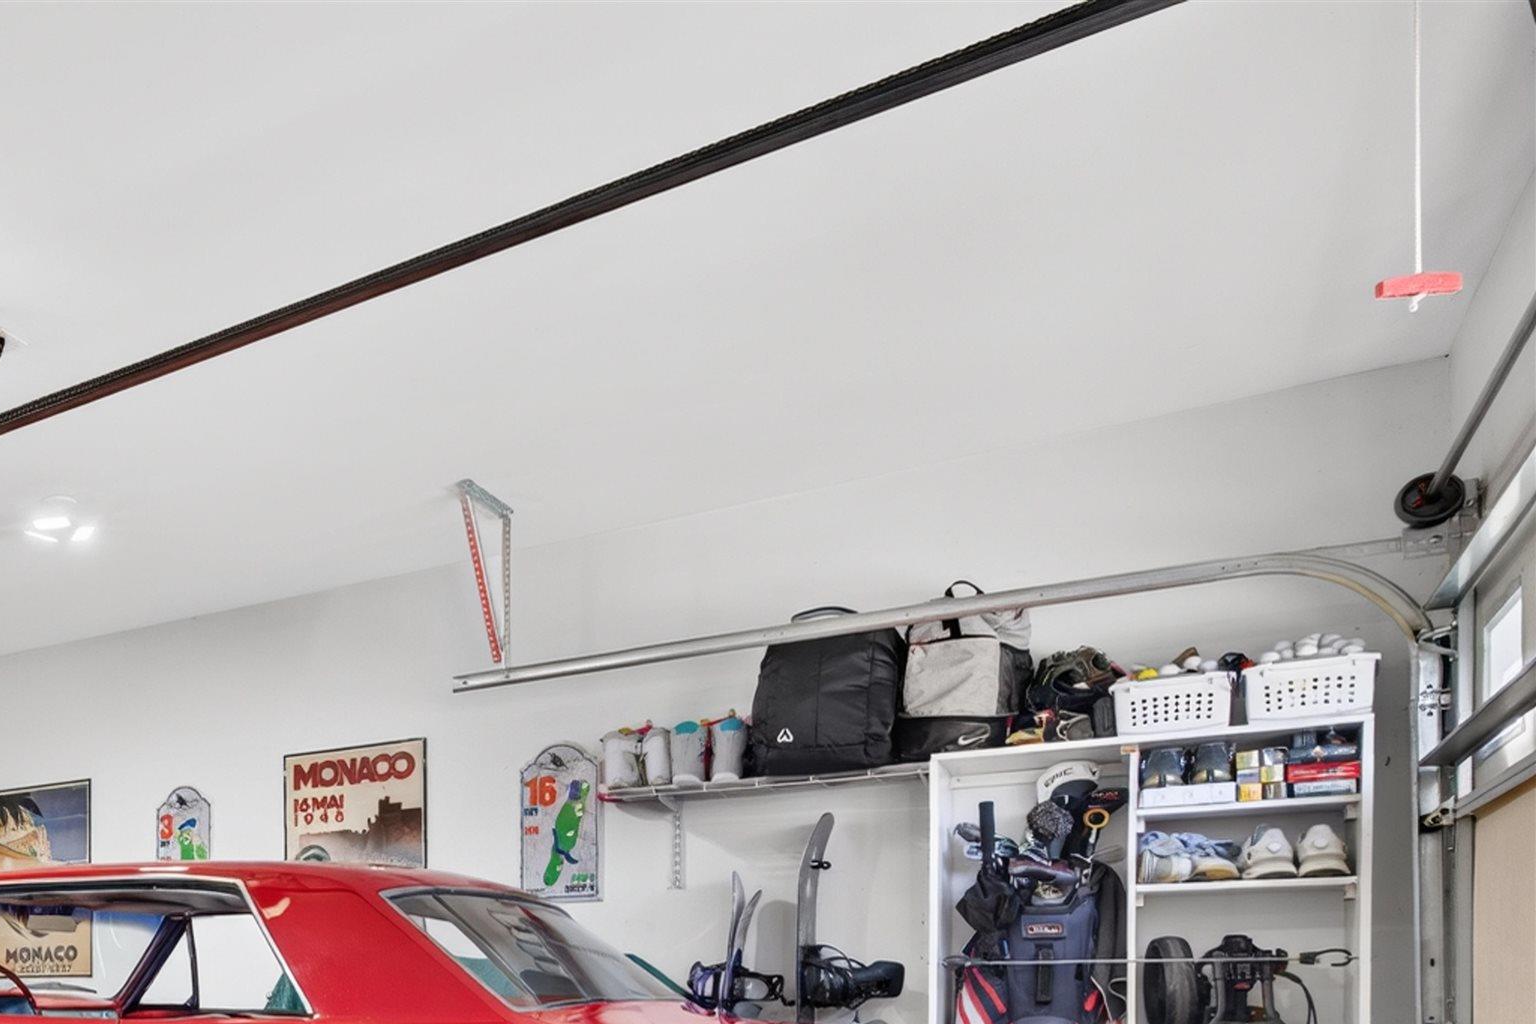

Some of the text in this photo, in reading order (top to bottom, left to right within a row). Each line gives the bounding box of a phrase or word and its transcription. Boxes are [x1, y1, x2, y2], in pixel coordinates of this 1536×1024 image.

[293, 751, 415, 791] MONACO
[524, 775, 557, 807] 16
[5, 945, 78, 964] MONACO
